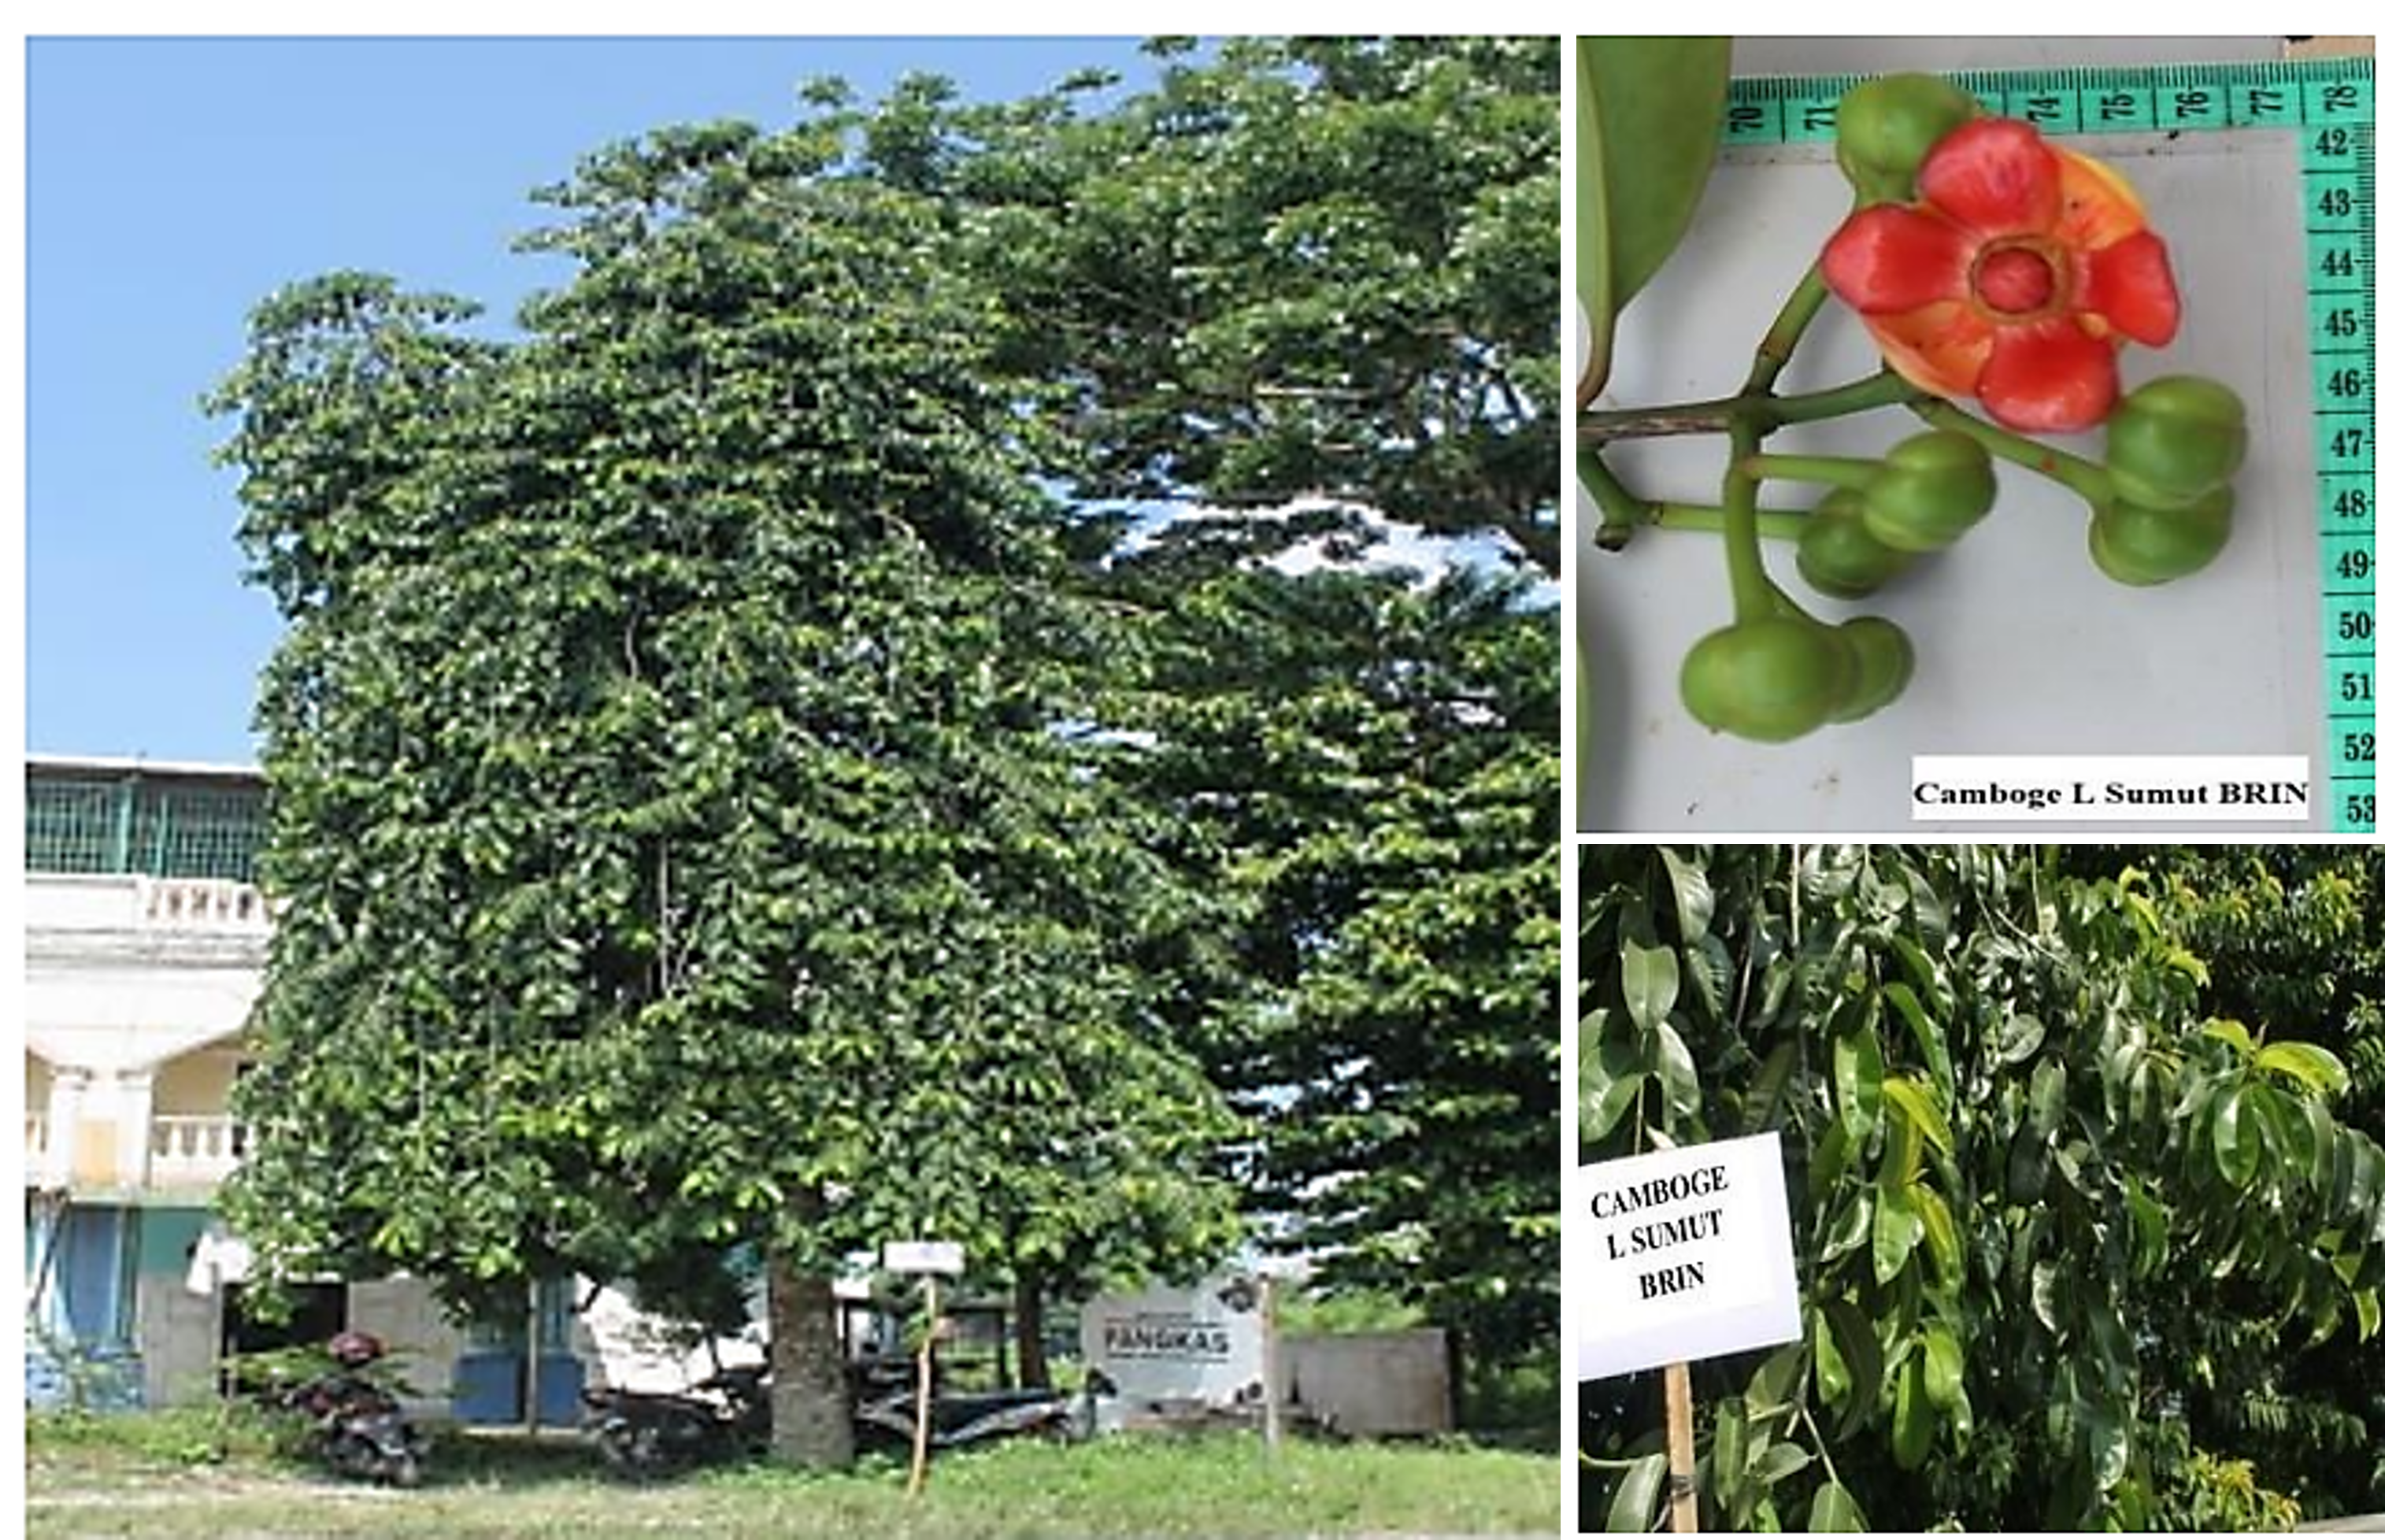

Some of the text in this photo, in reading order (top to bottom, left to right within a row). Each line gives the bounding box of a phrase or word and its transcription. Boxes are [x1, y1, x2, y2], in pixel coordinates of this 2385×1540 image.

[2027, 96, 2060, 124] 74
[2102, 93, 2135, 120] 75
[2176, 91, 2209, 117] 76
[2250, 88, 2283, 116] 77
[2324, 84, 2357, 112] 78
[1730, 106, 1764, 133] 70
[1804, 106, 1836, 131] 71
[2315, 128, 2349, 156] 42
[2317, 188, 2351, 217] 43
[2320, 249, 2354, 276] 44
[2324, 308, 2357, 336] 45
[2328, 368, 2361, 397] 46
[2331, 428, 2364, 457] 47
[2333, 489, 2368, 518] 48
[2335, 549, 2369, 579] 49
[2339, 610, 2372, 640] 50
[2342, 672, 2372, 702] 51
[2344, 733, 2376, 761] 52
[2347, 794, 2376, 824] 53
[1591, 1165, 1730, 1219] CAMBOGE
[1606, 1209, 1723, 1260] L SUMUT
[1638, 1261, 1705, 1300] BRIN
